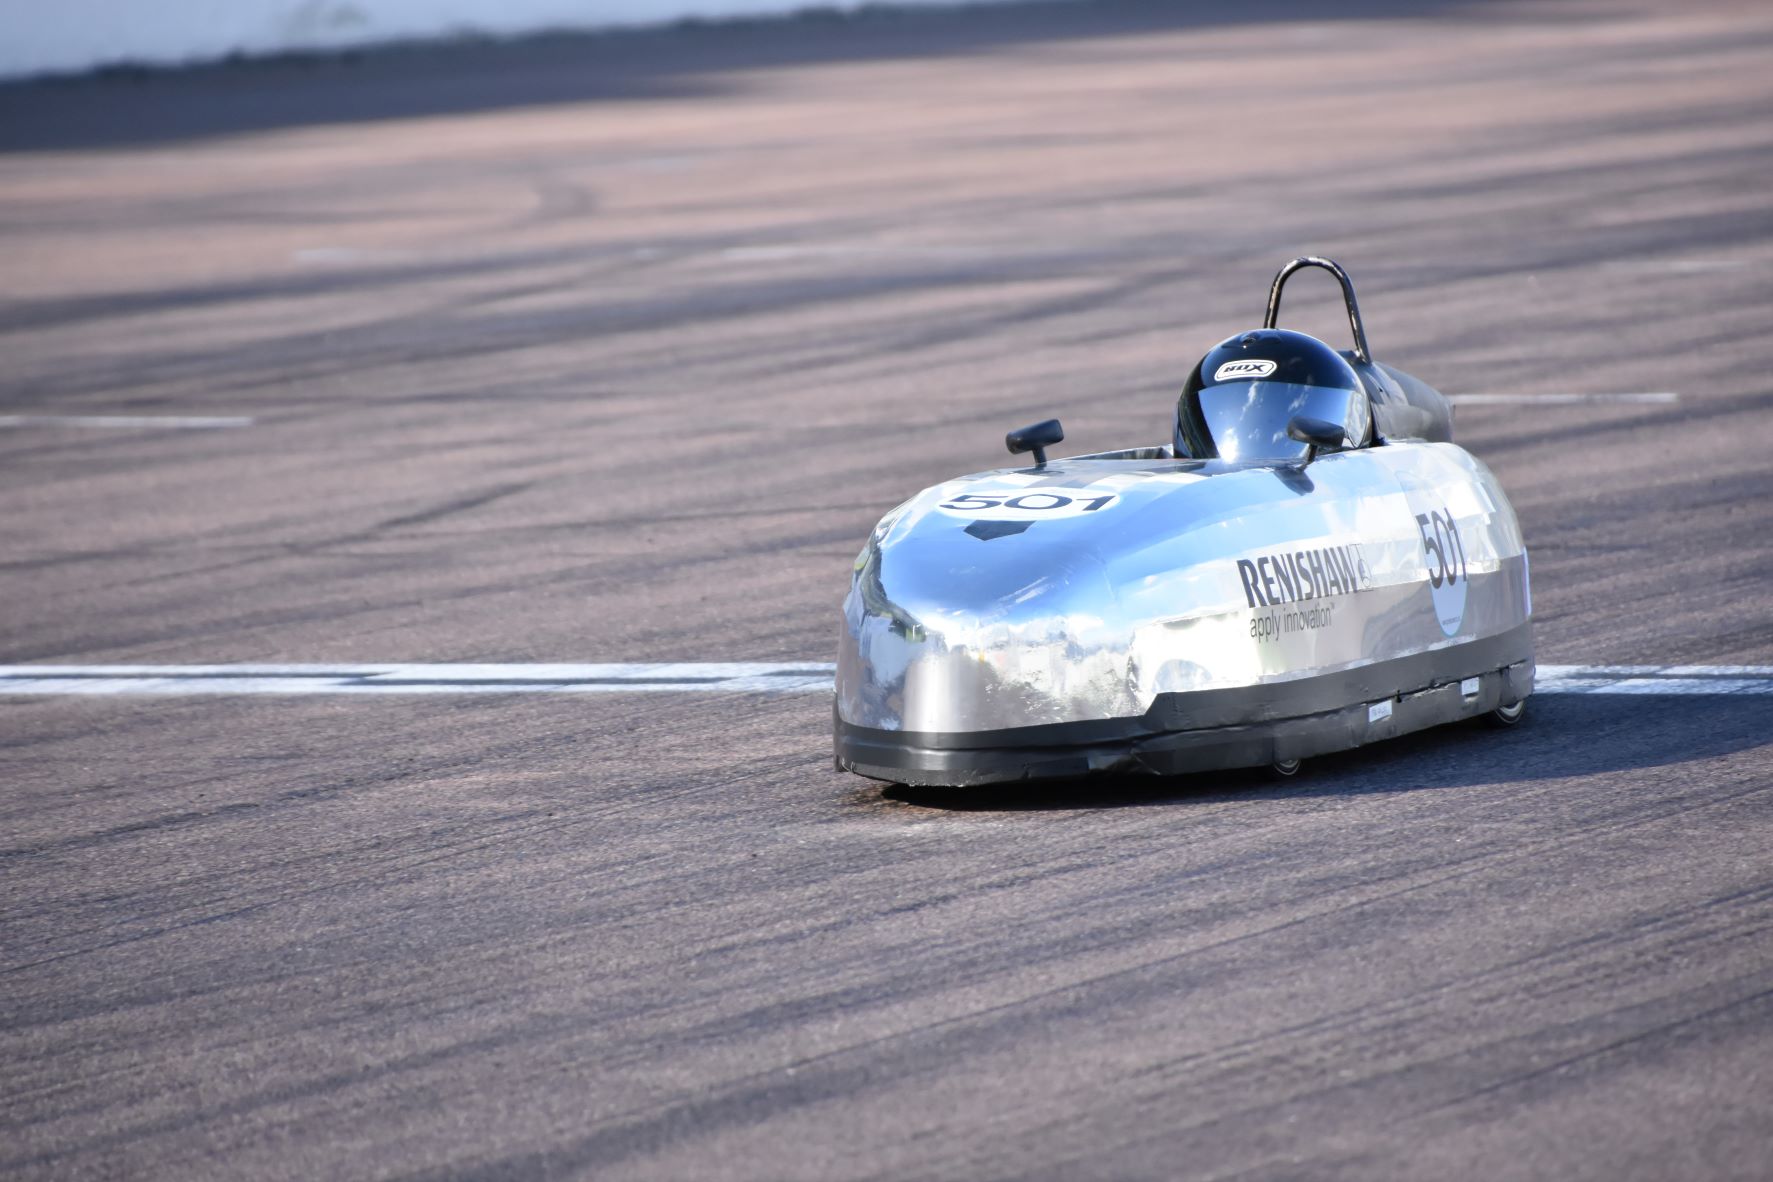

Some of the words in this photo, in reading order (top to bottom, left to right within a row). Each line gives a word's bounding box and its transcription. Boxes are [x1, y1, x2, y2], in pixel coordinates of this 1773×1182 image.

[939, 493, 1116, 511] 501
[1415, 507, 1467, 589] 501
[1236, 545, 1358, 608] RENISHAW
[1250, 609, 1281, 642] apply
